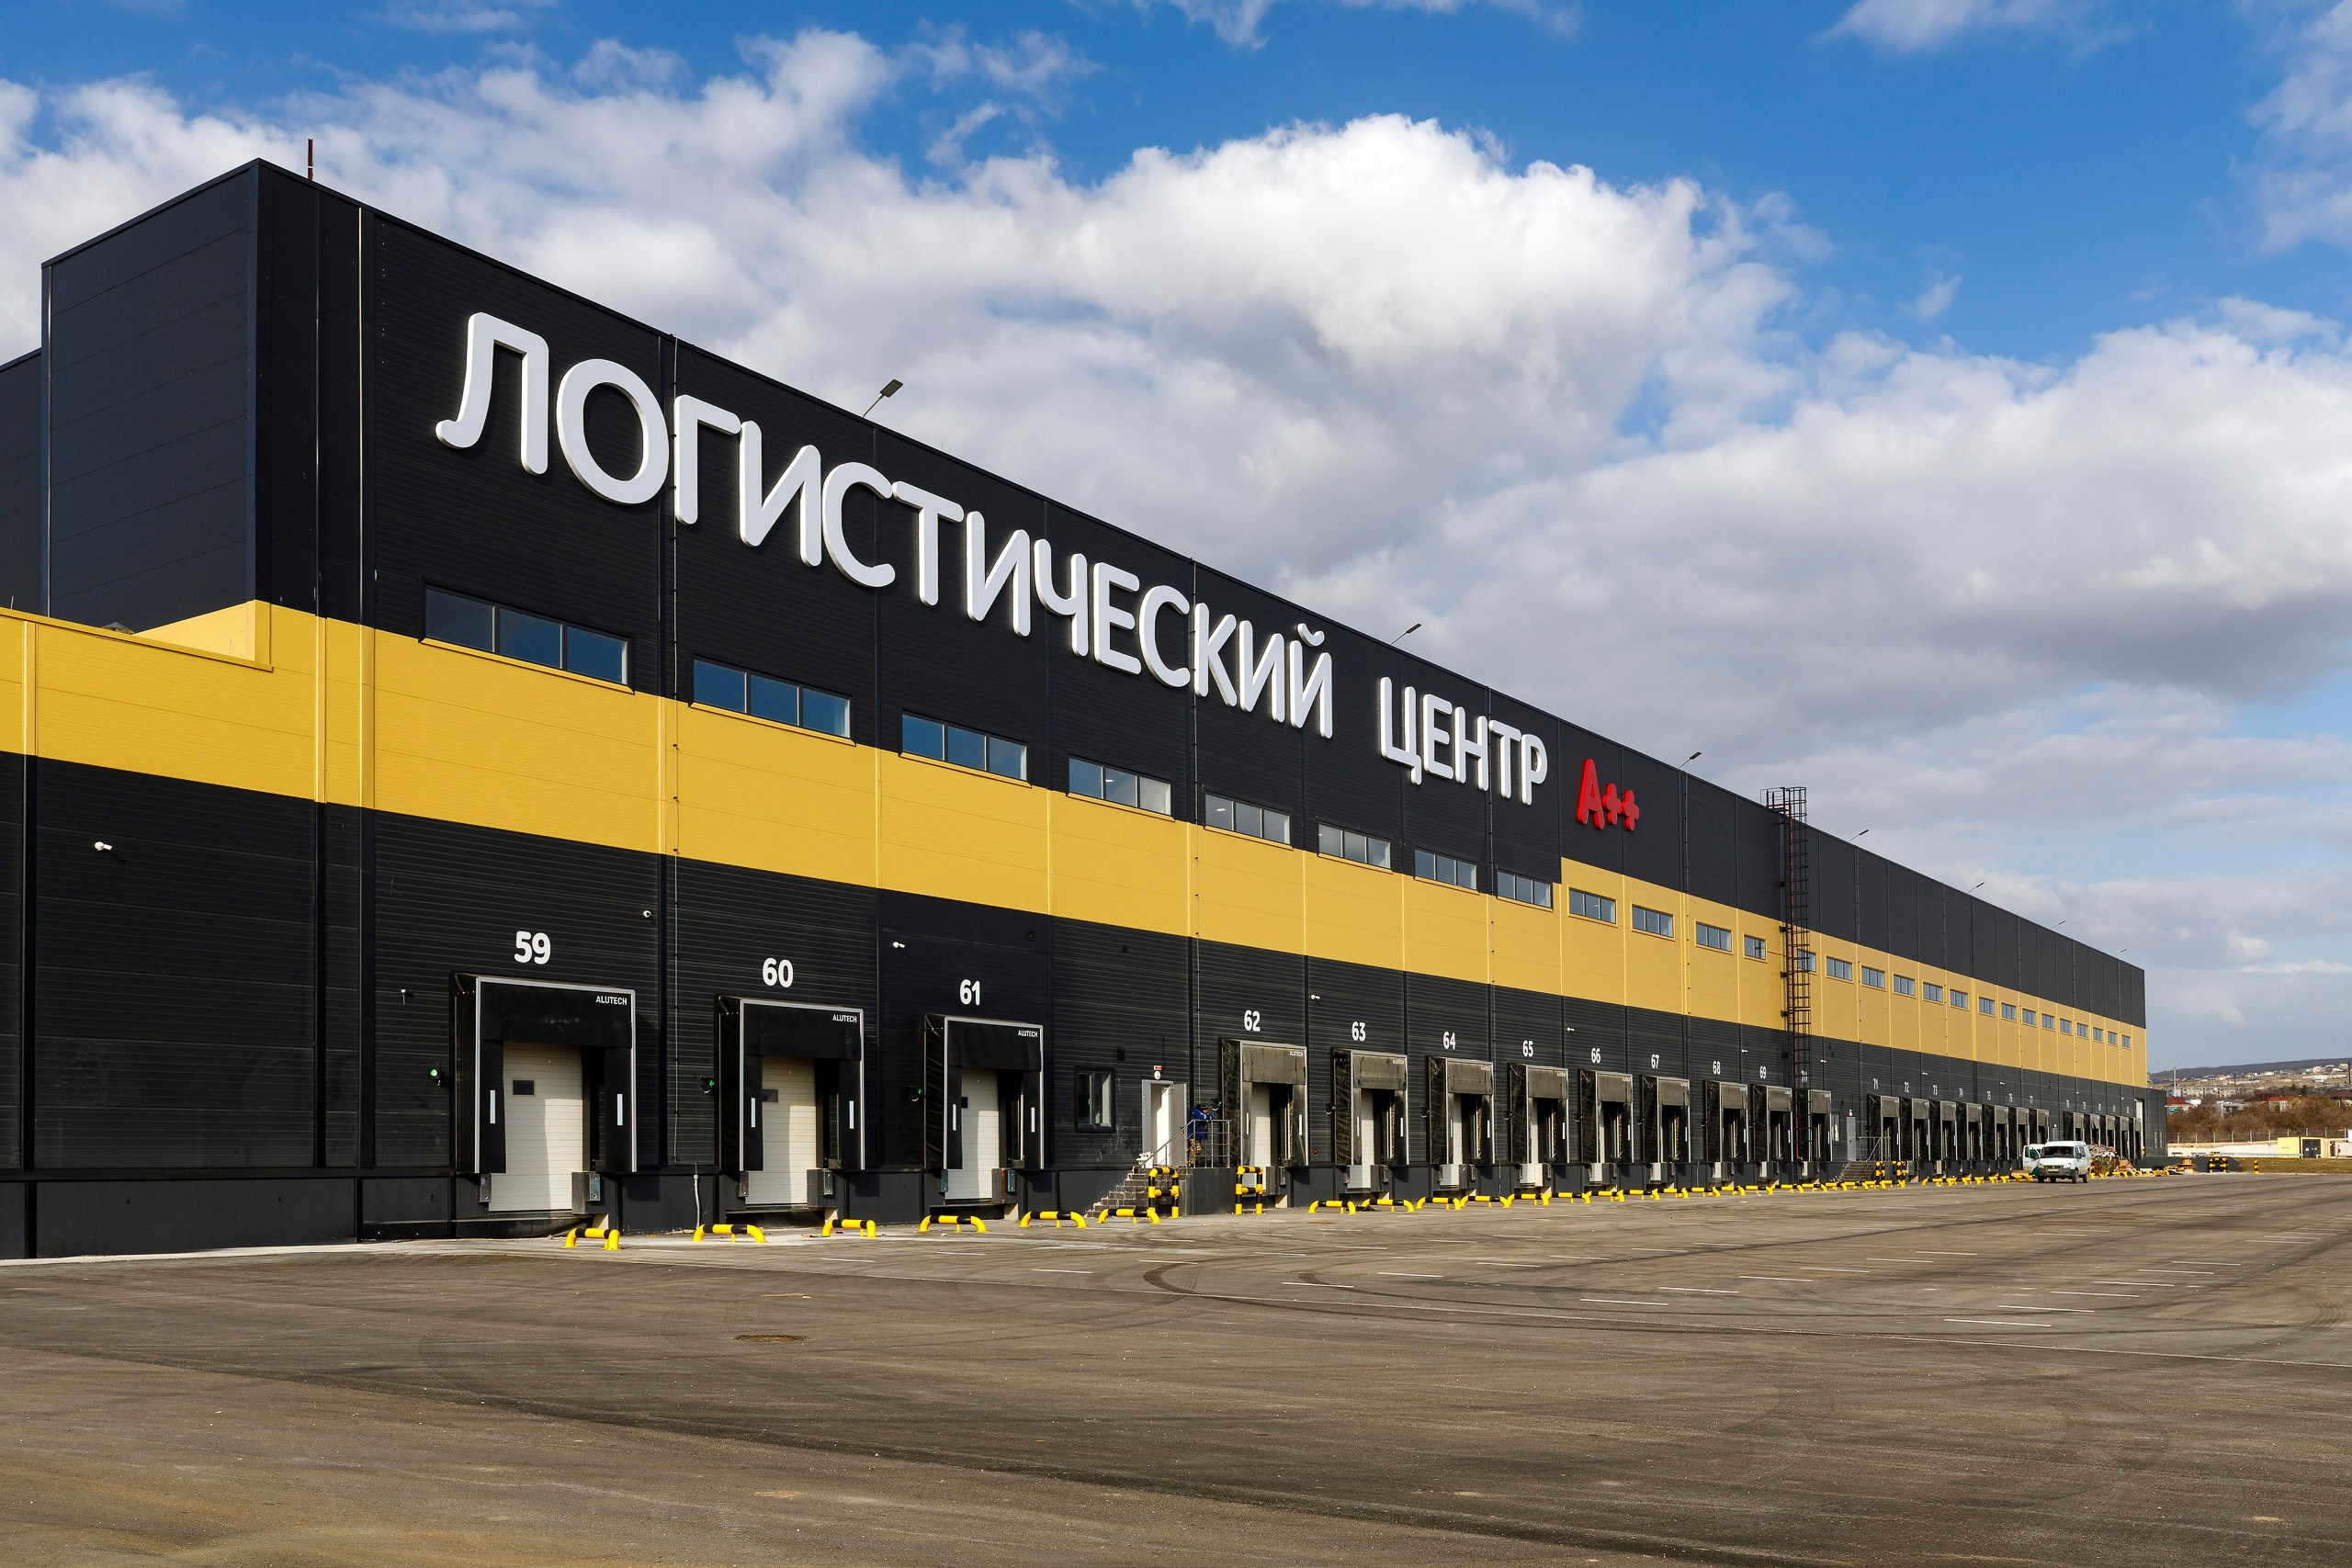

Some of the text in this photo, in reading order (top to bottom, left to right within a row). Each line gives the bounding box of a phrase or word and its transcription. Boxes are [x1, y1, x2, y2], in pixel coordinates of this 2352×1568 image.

[435, 311, 1333, 739] ЛОГИСТИЧЕСКИЙ
[1380, 676, 1548, 806] ЦЕНТР
[513, 931, 551, 965] 59
[762, 957, 794, 988] 60
[595, 995, 628, 1006] ALUTECH
[959, 979, 980, 1006] 61
[832, 1013, 857, 1023] ALUTECH
[1243, 1010, 1261, 1032] 62
[1018, 1029, 1038, 1038] ALUTECH
[1351, 1021, 1366, 1042] 63
[1442, 1031, 1456, 1050] 64
[1522, 1040, 1534, 1057] 65
[1590, 1047, 1601, 1065] 66
[1650, 1054, 1660, 1069] 67
[1713, 1060, 1722, 1076] 68
[1759, 1066, 1767, 1079] 69
